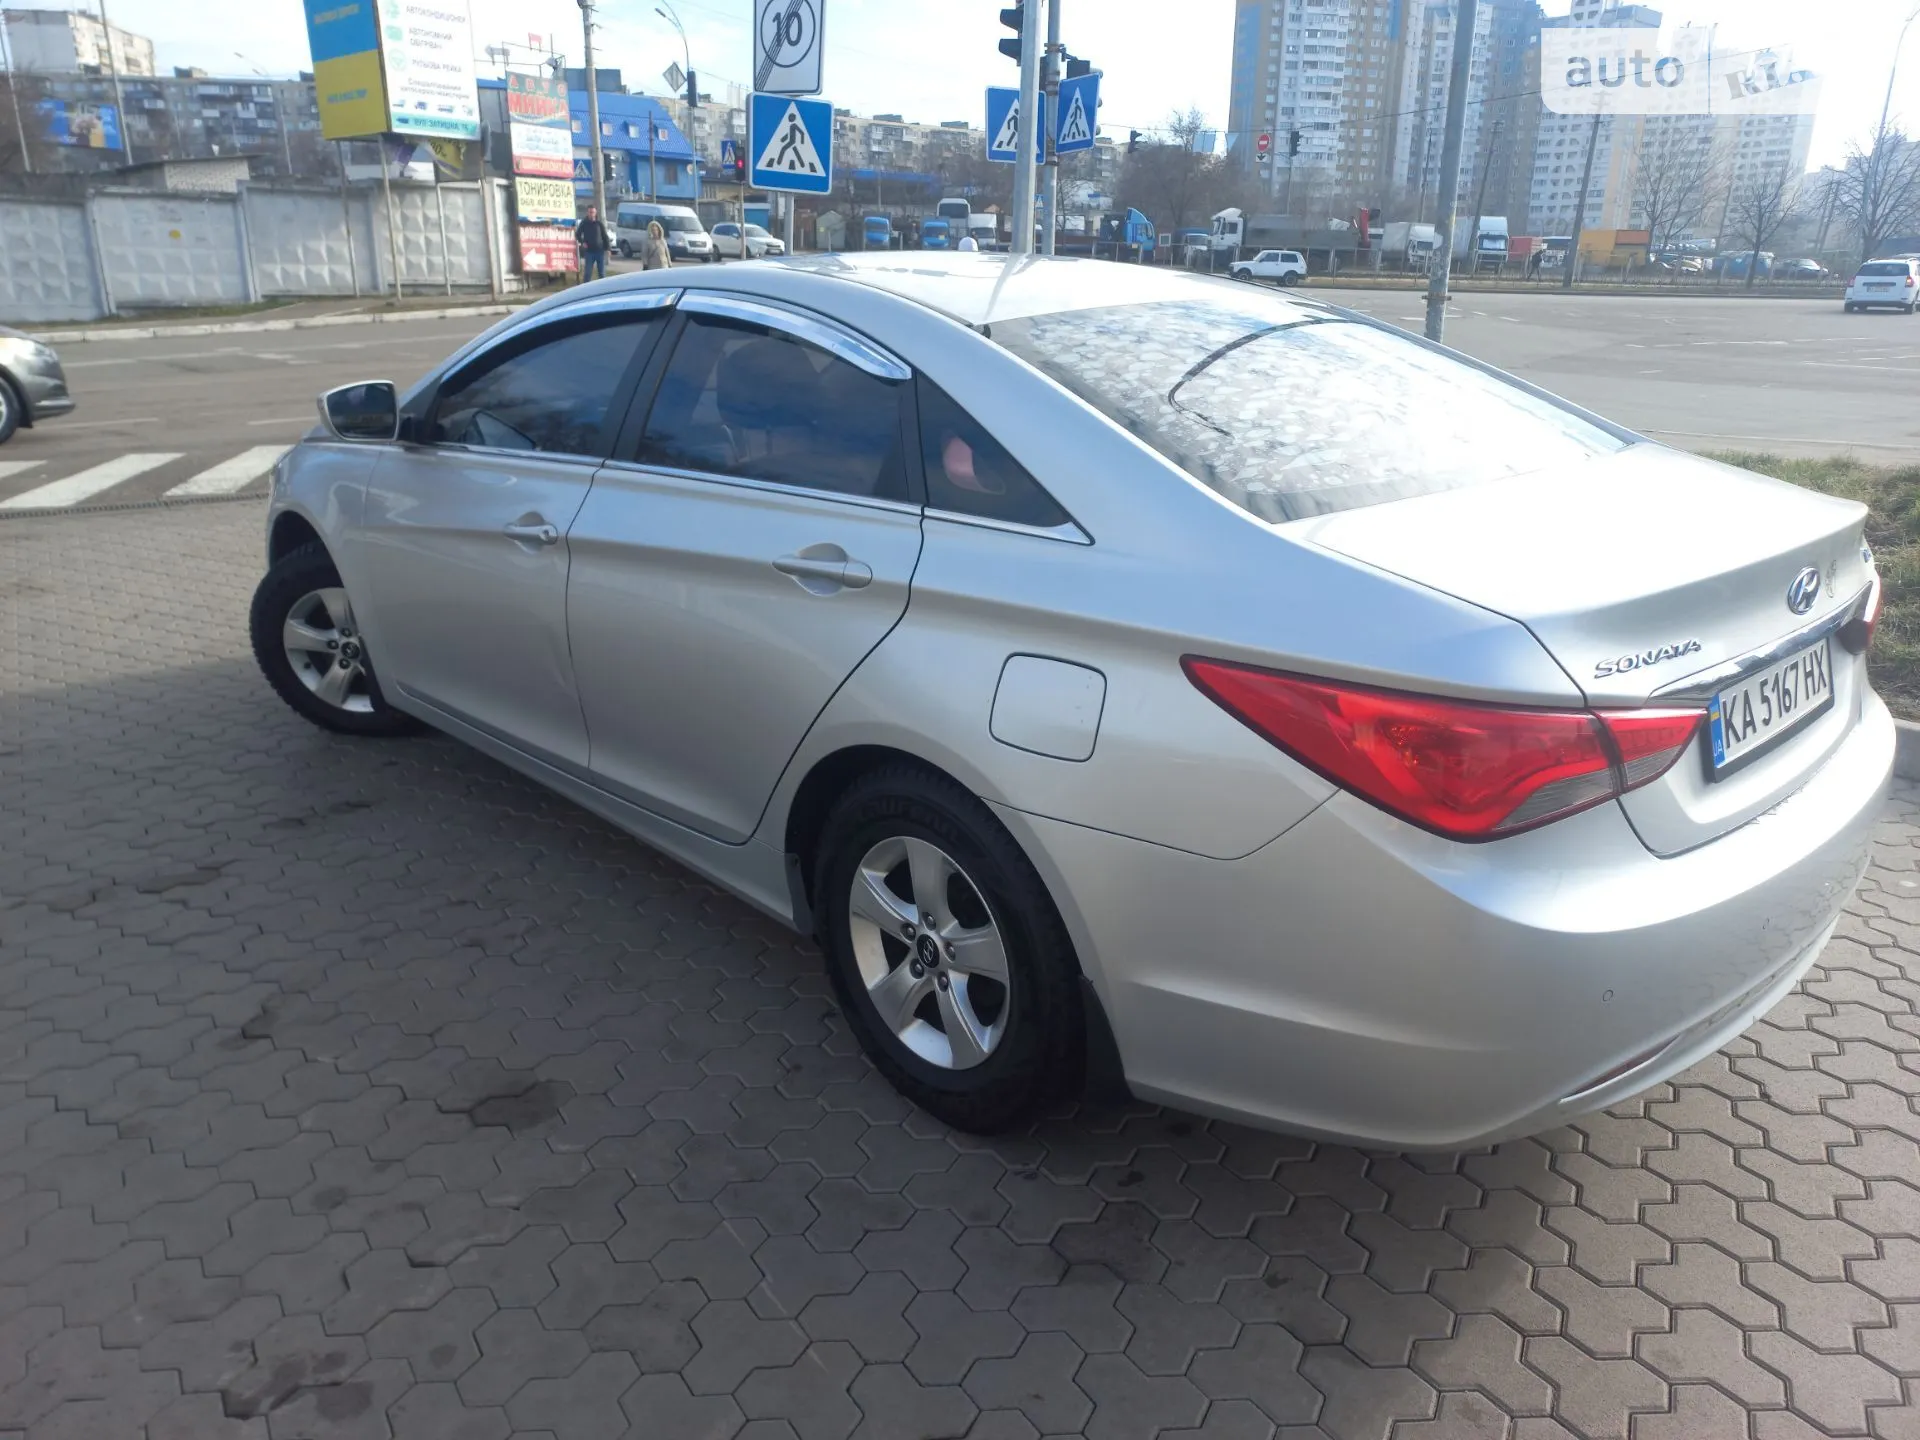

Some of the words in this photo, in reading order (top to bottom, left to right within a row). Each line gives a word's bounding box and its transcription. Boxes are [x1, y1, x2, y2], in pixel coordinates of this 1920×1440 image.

[772, 12, 802, 47] 10
[518, 181, 573, 199] ТОНИРОВКА
[1594, 637, 1702, 679] SONATA
[1722, 688, 1757, 750] KA
[1760, 659, 1800, 727] 5167
[1802, 643, 1828, 702] HX
[1713, 738, 1723, 758] UA
